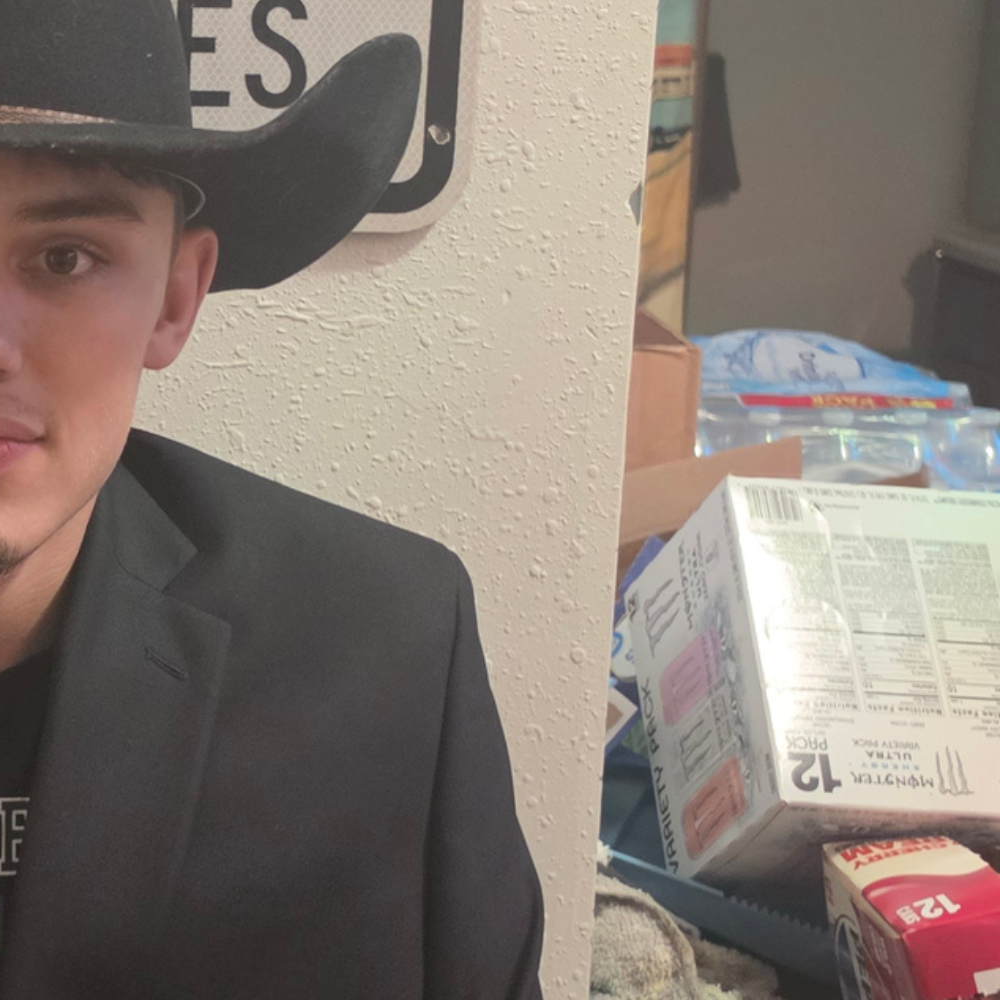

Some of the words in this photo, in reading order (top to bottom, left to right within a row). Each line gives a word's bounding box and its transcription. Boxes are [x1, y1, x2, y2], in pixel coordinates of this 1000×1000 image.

[640, 677, 660, 754] PACK
[786, 736, 828, 751] PACK
[866, 750, 912, 761] ULTRA
[787, 752, 842, 793] 12
[851, 771, 934, 789] MONSTER
[654, 766, 680, 874] VARIETY
[913, 893, 961, 919] 12
